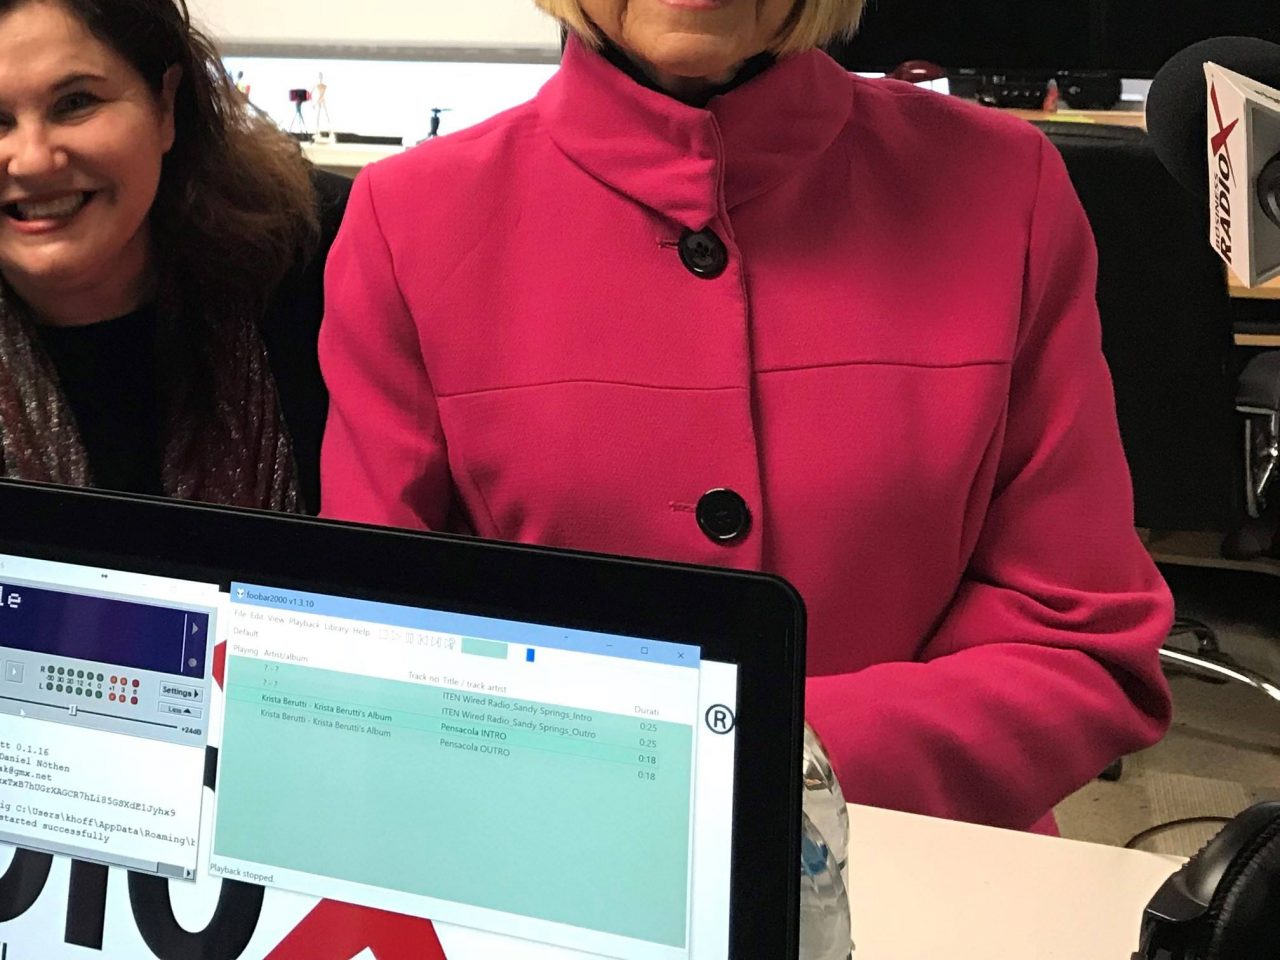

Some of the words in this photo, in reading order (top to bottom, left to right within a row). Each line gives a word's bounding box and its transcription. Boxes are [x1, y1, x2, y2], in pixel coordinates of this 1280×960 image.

[1218, 152, 1232, 264] RADIO
[246, 591, 287, 604] foobar2000
[289, 597, 314, 608] v1.3.10
[234, 609, 247, 618] File
[250, 611, 264, 621] Edit
[267, 615, 285, 624] View
[289, 617, 320, 629] Playback
[324, 623, 349, 634] Library
[352, 627, 370, 637] Help
[233, 627, 259, 638] Default
[233, 645, 259, 656] Playing
[264, 649, 309, 663] Artist/album
[162, 685, 192, 698] Settings
[408, 672, 427, 682] Track
[442, 676, 459, 686] Title
[466, 681, 485, 691] track
[487, 685, 507, 693] artist
[261, 694, 282, 705] Krista
[283, 697, 307, 708] Berutti
[314, 702, 334, 713] Krista
[336, 706, 366, 718] Berutti's
[367, 711, 393, 722] Album
[442, 692, 461, 702] ITEN
[462, 695, 486, 706] Wired
[488, 699, 538, 715] Radio_Sandy
[540, 707, 593, 722] Springs_Intro
[182, 727, 202, 735] +24dB
[261, 709, 281, 720] Krista
[281, 712, 306, 723] Berutti
[312, 717, 334, 728] Krista
[335, 721, 365, 733] Berutti's
[366, 726, 391, 737] Album
[441, 707, 460, 718] ITEN
[462, 710, 485, 722] Wired
[487, 714, 537, 731] Radio_Sandy
[539, 723, 597, 739] Springs_Outro
[441, 723, 479, 737] Pensacola
[481, 729, 507, 741] INTRO
[640, 722, 658, 732] 0:25
[16, 743, 49, 756] 0.1.16
[440, 738, 479, 752] Pensacola
[479, 744, 510, 757] OUTRO
[639, 738, 657, 749] 0:25
[0, 753, 31, 765] Daniel
[638, 754, 656, 765] 0:18
[637, 770, 656, 781] 0:18
[0, 814, 37, 827] started
[42, 822, 110, 844] successfully
[210, 863, 241, 877] Playback
[243, 871, 274, 883] stopped.
